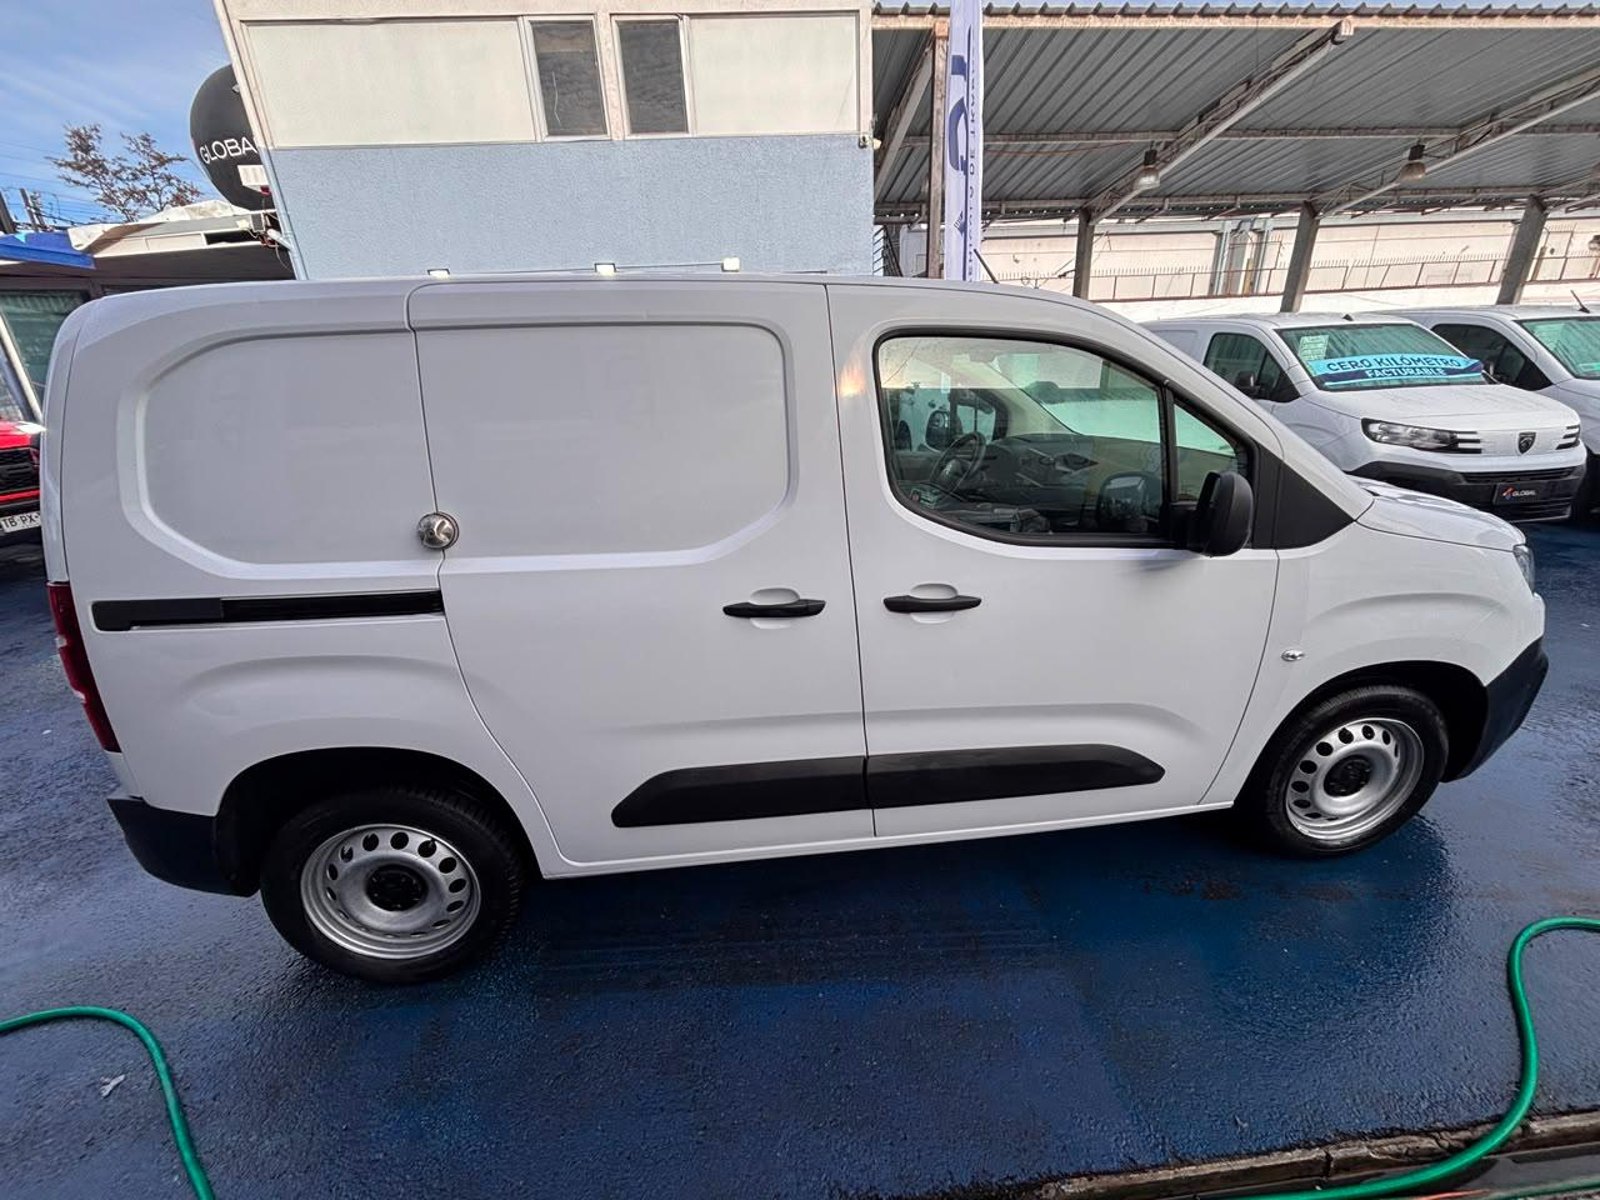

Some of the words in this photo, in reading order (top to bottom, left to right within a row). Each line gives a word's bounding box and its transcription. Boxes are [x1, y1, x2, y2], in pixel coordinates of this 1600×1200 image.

[199, 136, 258, 164] GLOBA
[1327, 357, 1372, 372] CERO
[1374, 353, 1462, 368] KILÓMETRO
[1365, 367, 1446, 378] FACTURABLE
[1512, 489, 1536, 497] GLOBAL
